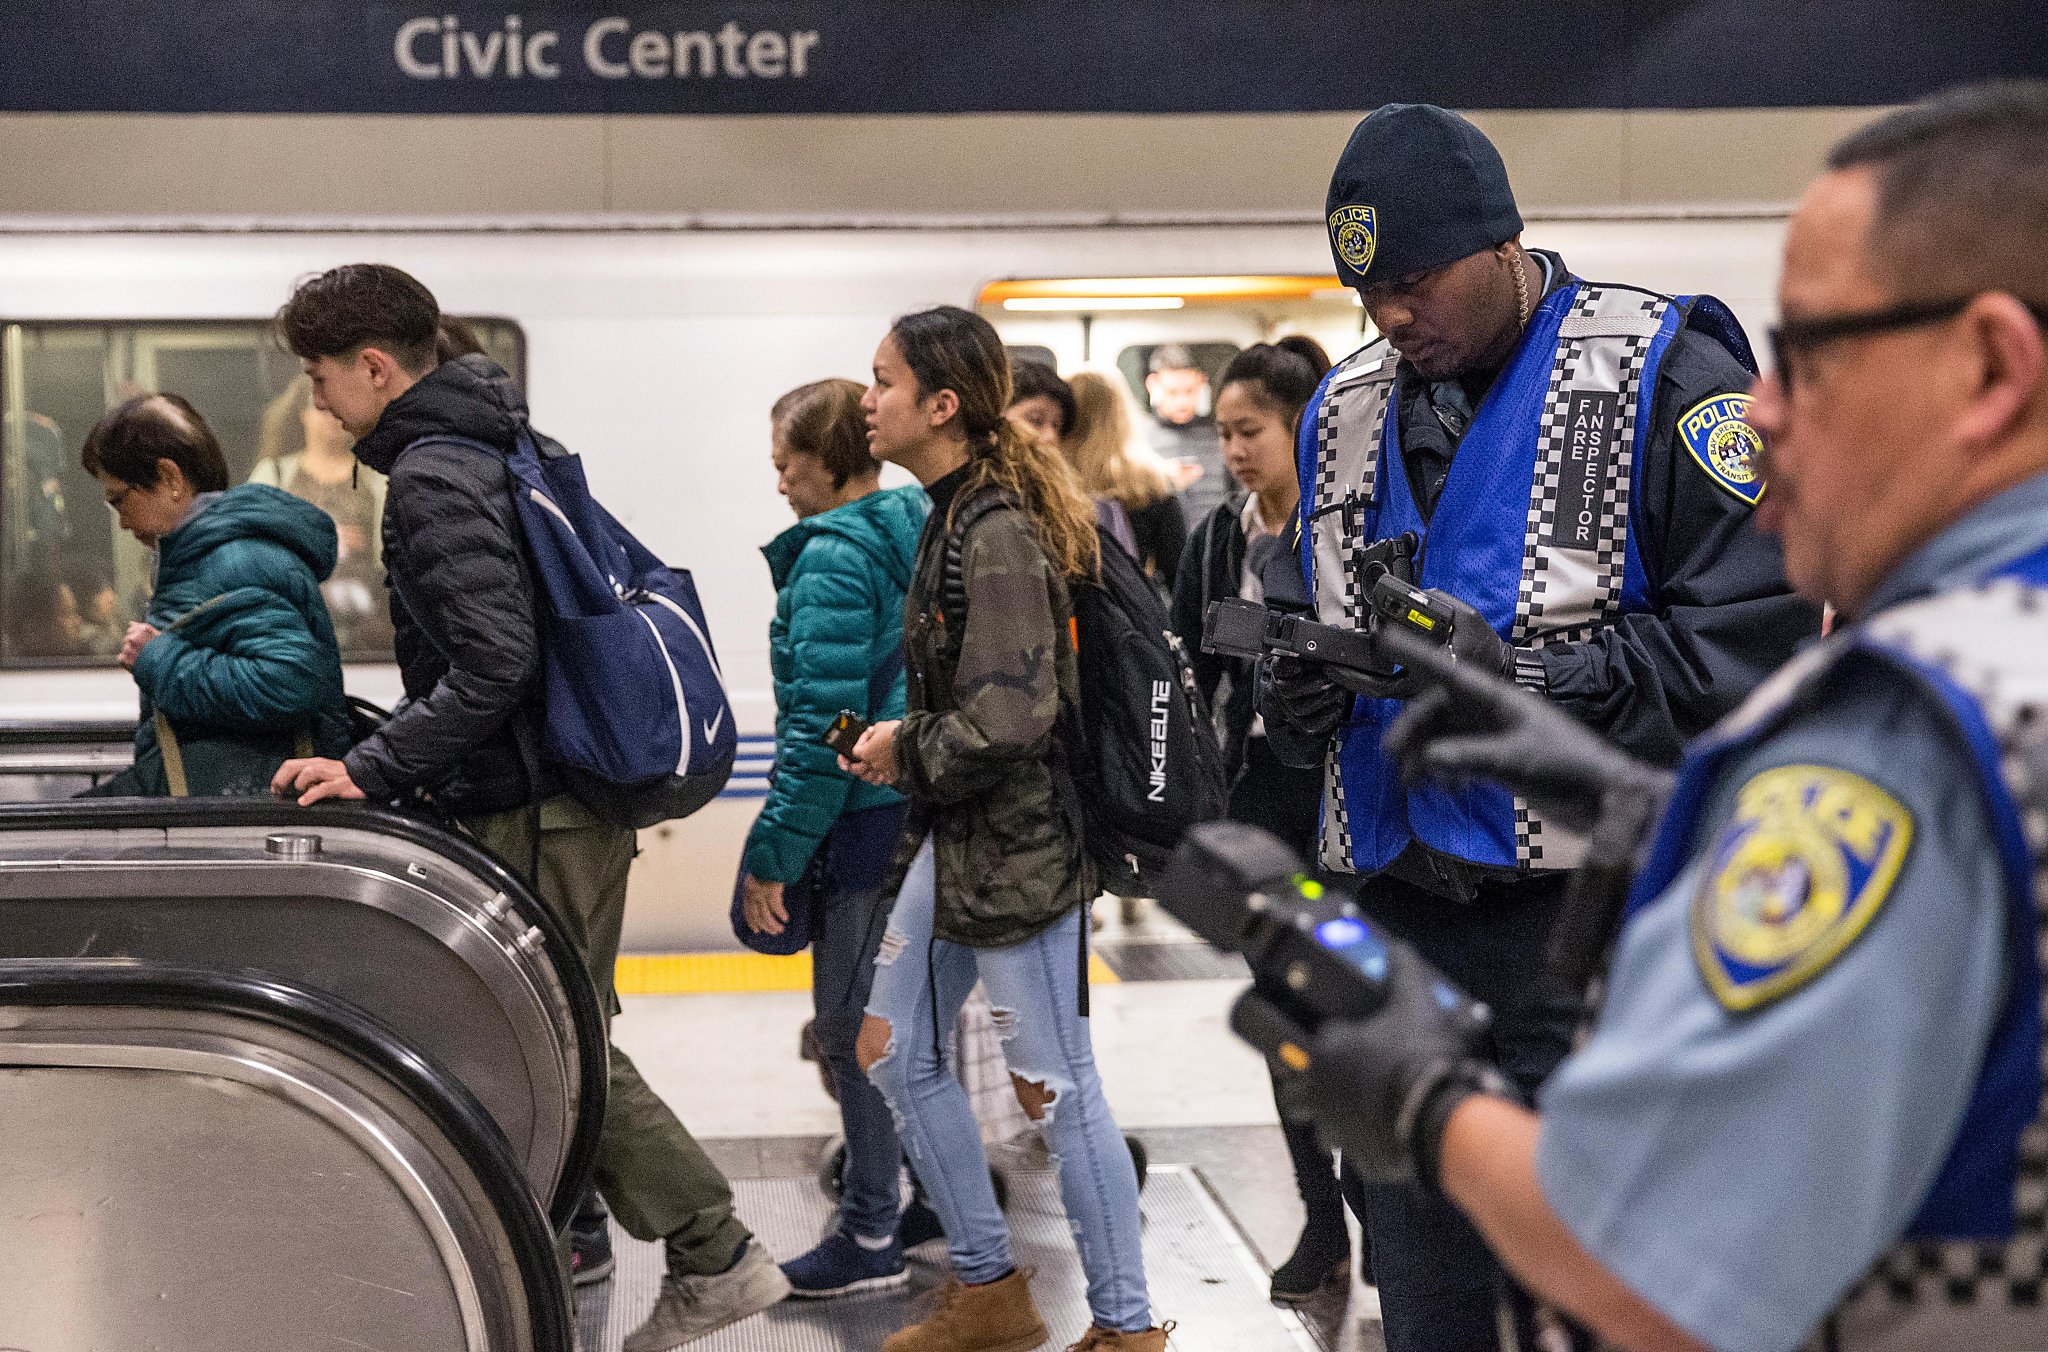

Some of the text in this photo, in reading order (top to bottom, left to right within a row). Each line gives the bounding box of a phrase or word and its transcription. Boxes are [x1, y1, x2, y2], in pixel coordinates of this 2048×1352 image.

[394, 15, 820, 79] Civic Center
[1331, 209, 1371, 231] POLICE
[1571, 399, 1591, 460] FARE
[1716, 423, 1735, 438] AREA
[1737, 424, 1759, 443] RAPID
[1575, 399, 1603, 541] INSPECTOR
[1716, 462, 1749, 480] TRANSIT
